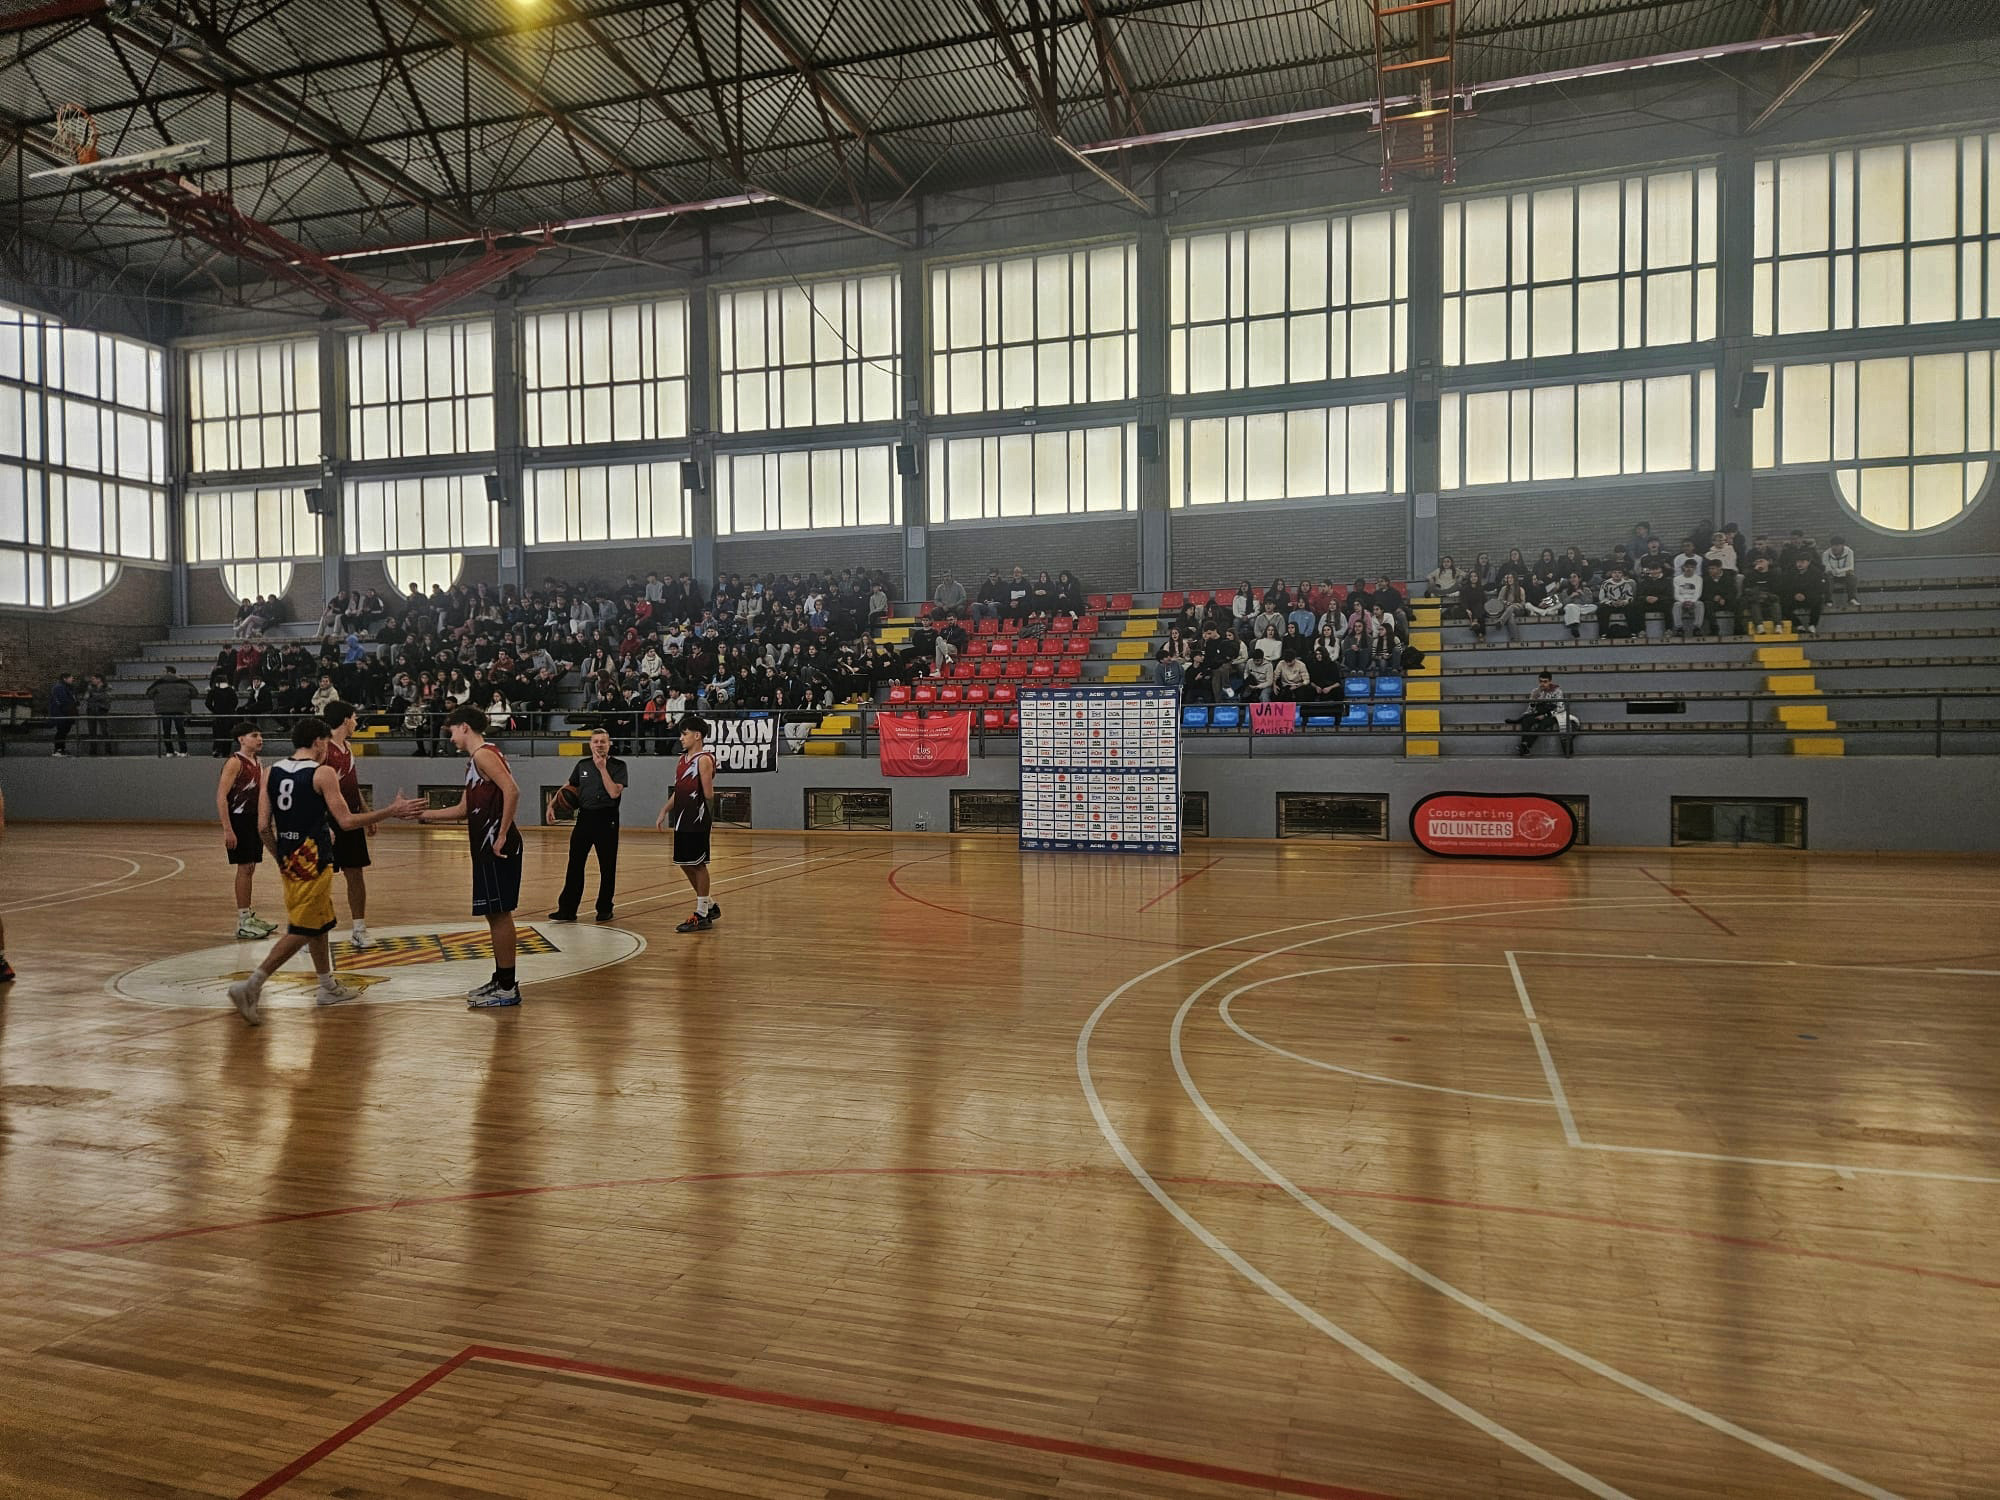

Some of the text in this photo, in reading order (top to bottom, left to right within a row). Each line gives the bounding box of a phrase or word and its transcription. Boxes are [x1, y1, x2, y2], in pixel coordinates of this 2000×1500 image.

[1256, 703, 1284, 716] JAN
[703, 719, 774, 743] DIXON
[277, 778, 294, 811] 8
[1428, 808, 1514, 820] Cooperating
[1431, 822, 1512, 836] VOLUNTEERS
